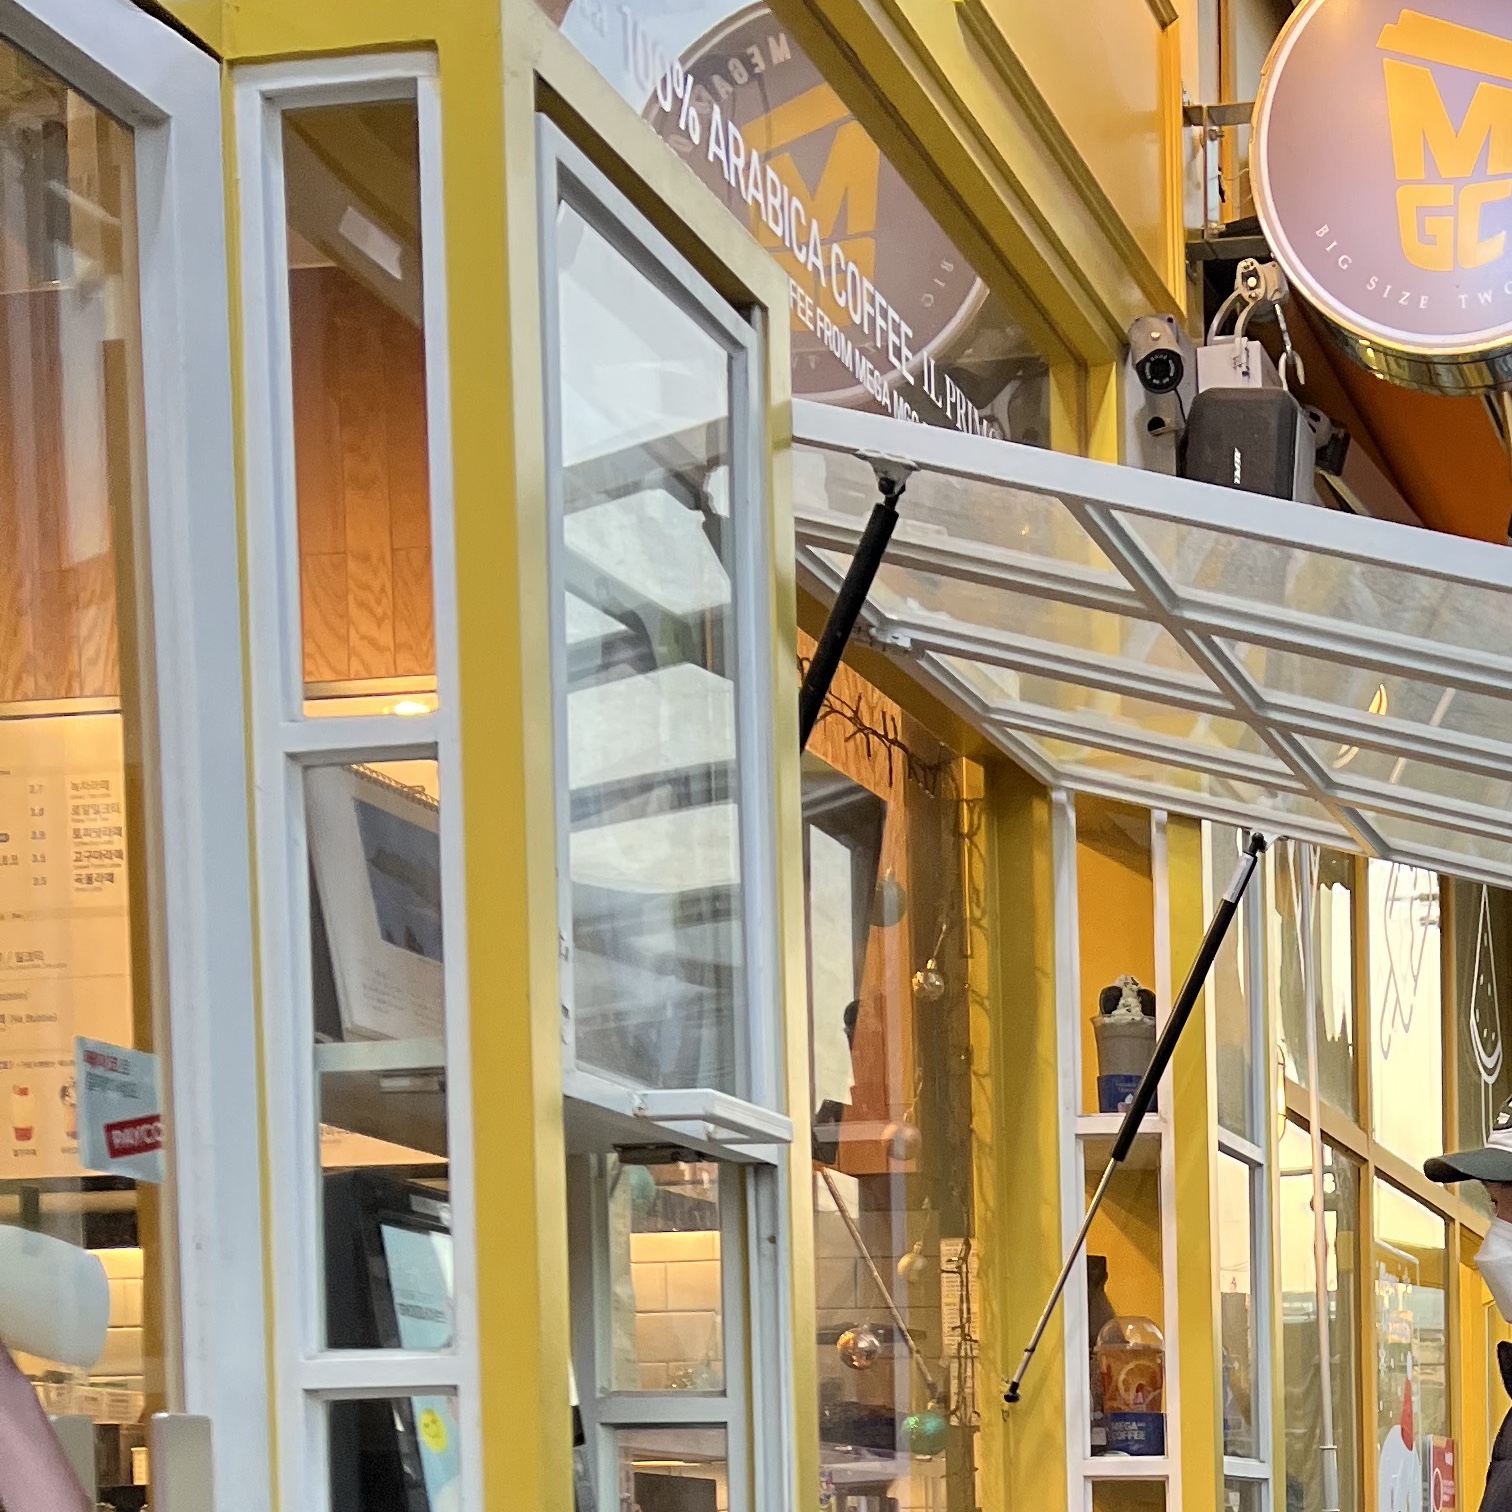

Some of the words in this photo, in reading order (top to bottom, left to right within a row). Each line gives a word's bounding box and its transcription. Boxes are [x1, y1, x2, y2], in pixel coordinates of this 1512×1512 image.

[707, 103, 826, 287] ARABICA
[831, 243, 914, 385] COFFEE
[1315, 224, 1352, 270] BIG
[1365, 276, 1429, 309] SIZE
[816, 306, 853, 372] FROM
[853, 347, 893, 413] MEGA
